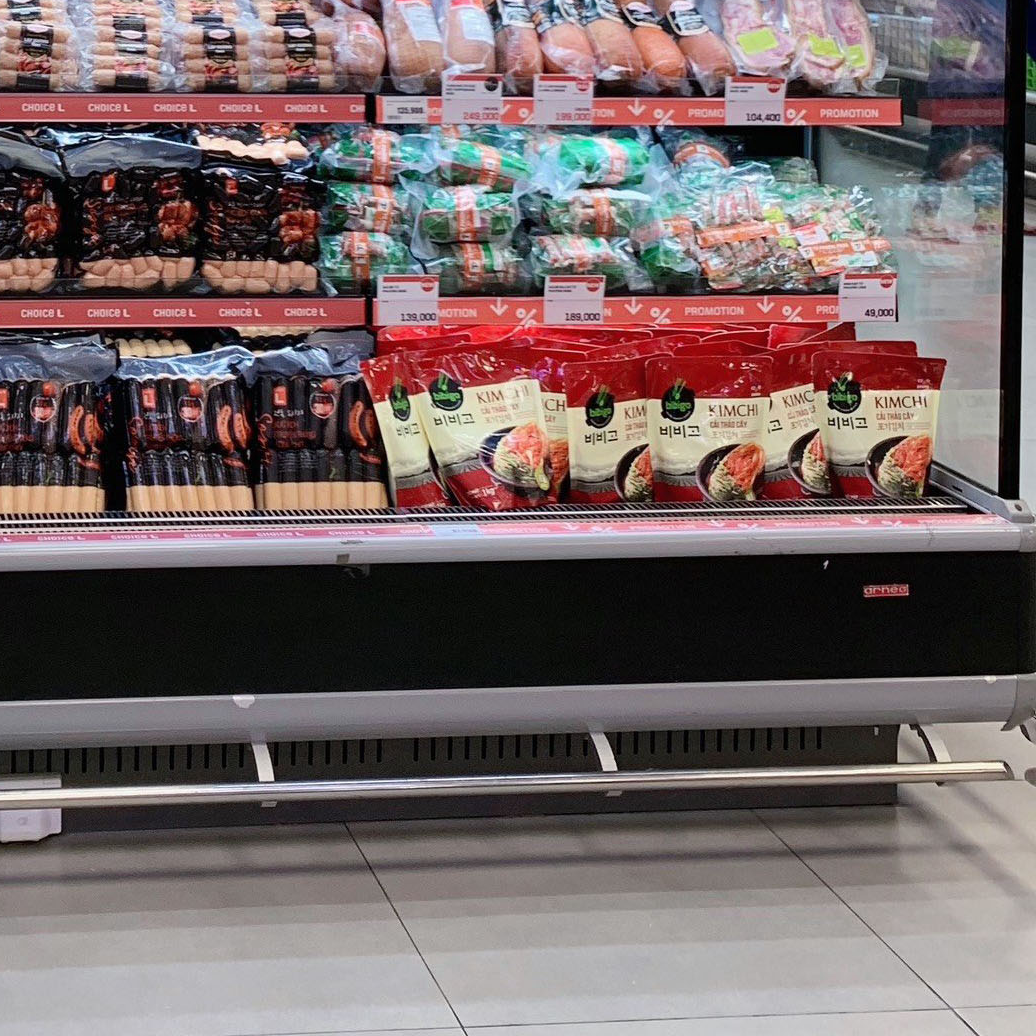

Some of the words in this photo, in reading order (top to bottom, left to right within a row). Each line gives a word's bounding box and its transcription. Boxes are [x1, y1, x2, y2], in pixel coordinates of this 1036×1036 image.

[688, 109, 724, 118] PROMO
[746, 113, 781, 123] 104,400
[820, 109, 879, 118] PROMOTION
[565, 313, 601, 322] 189,000
[685, 306, 744, 316] PROMOTION
[865, 308, 894, 318] 49,000
[400, 313, 437, 323] 139,000
[782, 391, 814, 408] KIMC
[875, 396, 928, 409] KIMCHI
[624, 405, 646, 418] KIM
[708, 404, 759, 417] KIMCHI
[434, 413, 475, 426] 비비고
[828, 416, 868, 430] 비비고
[584, 430, 619, 445] 비비고
[659, 425, 701, 438] 비비고
